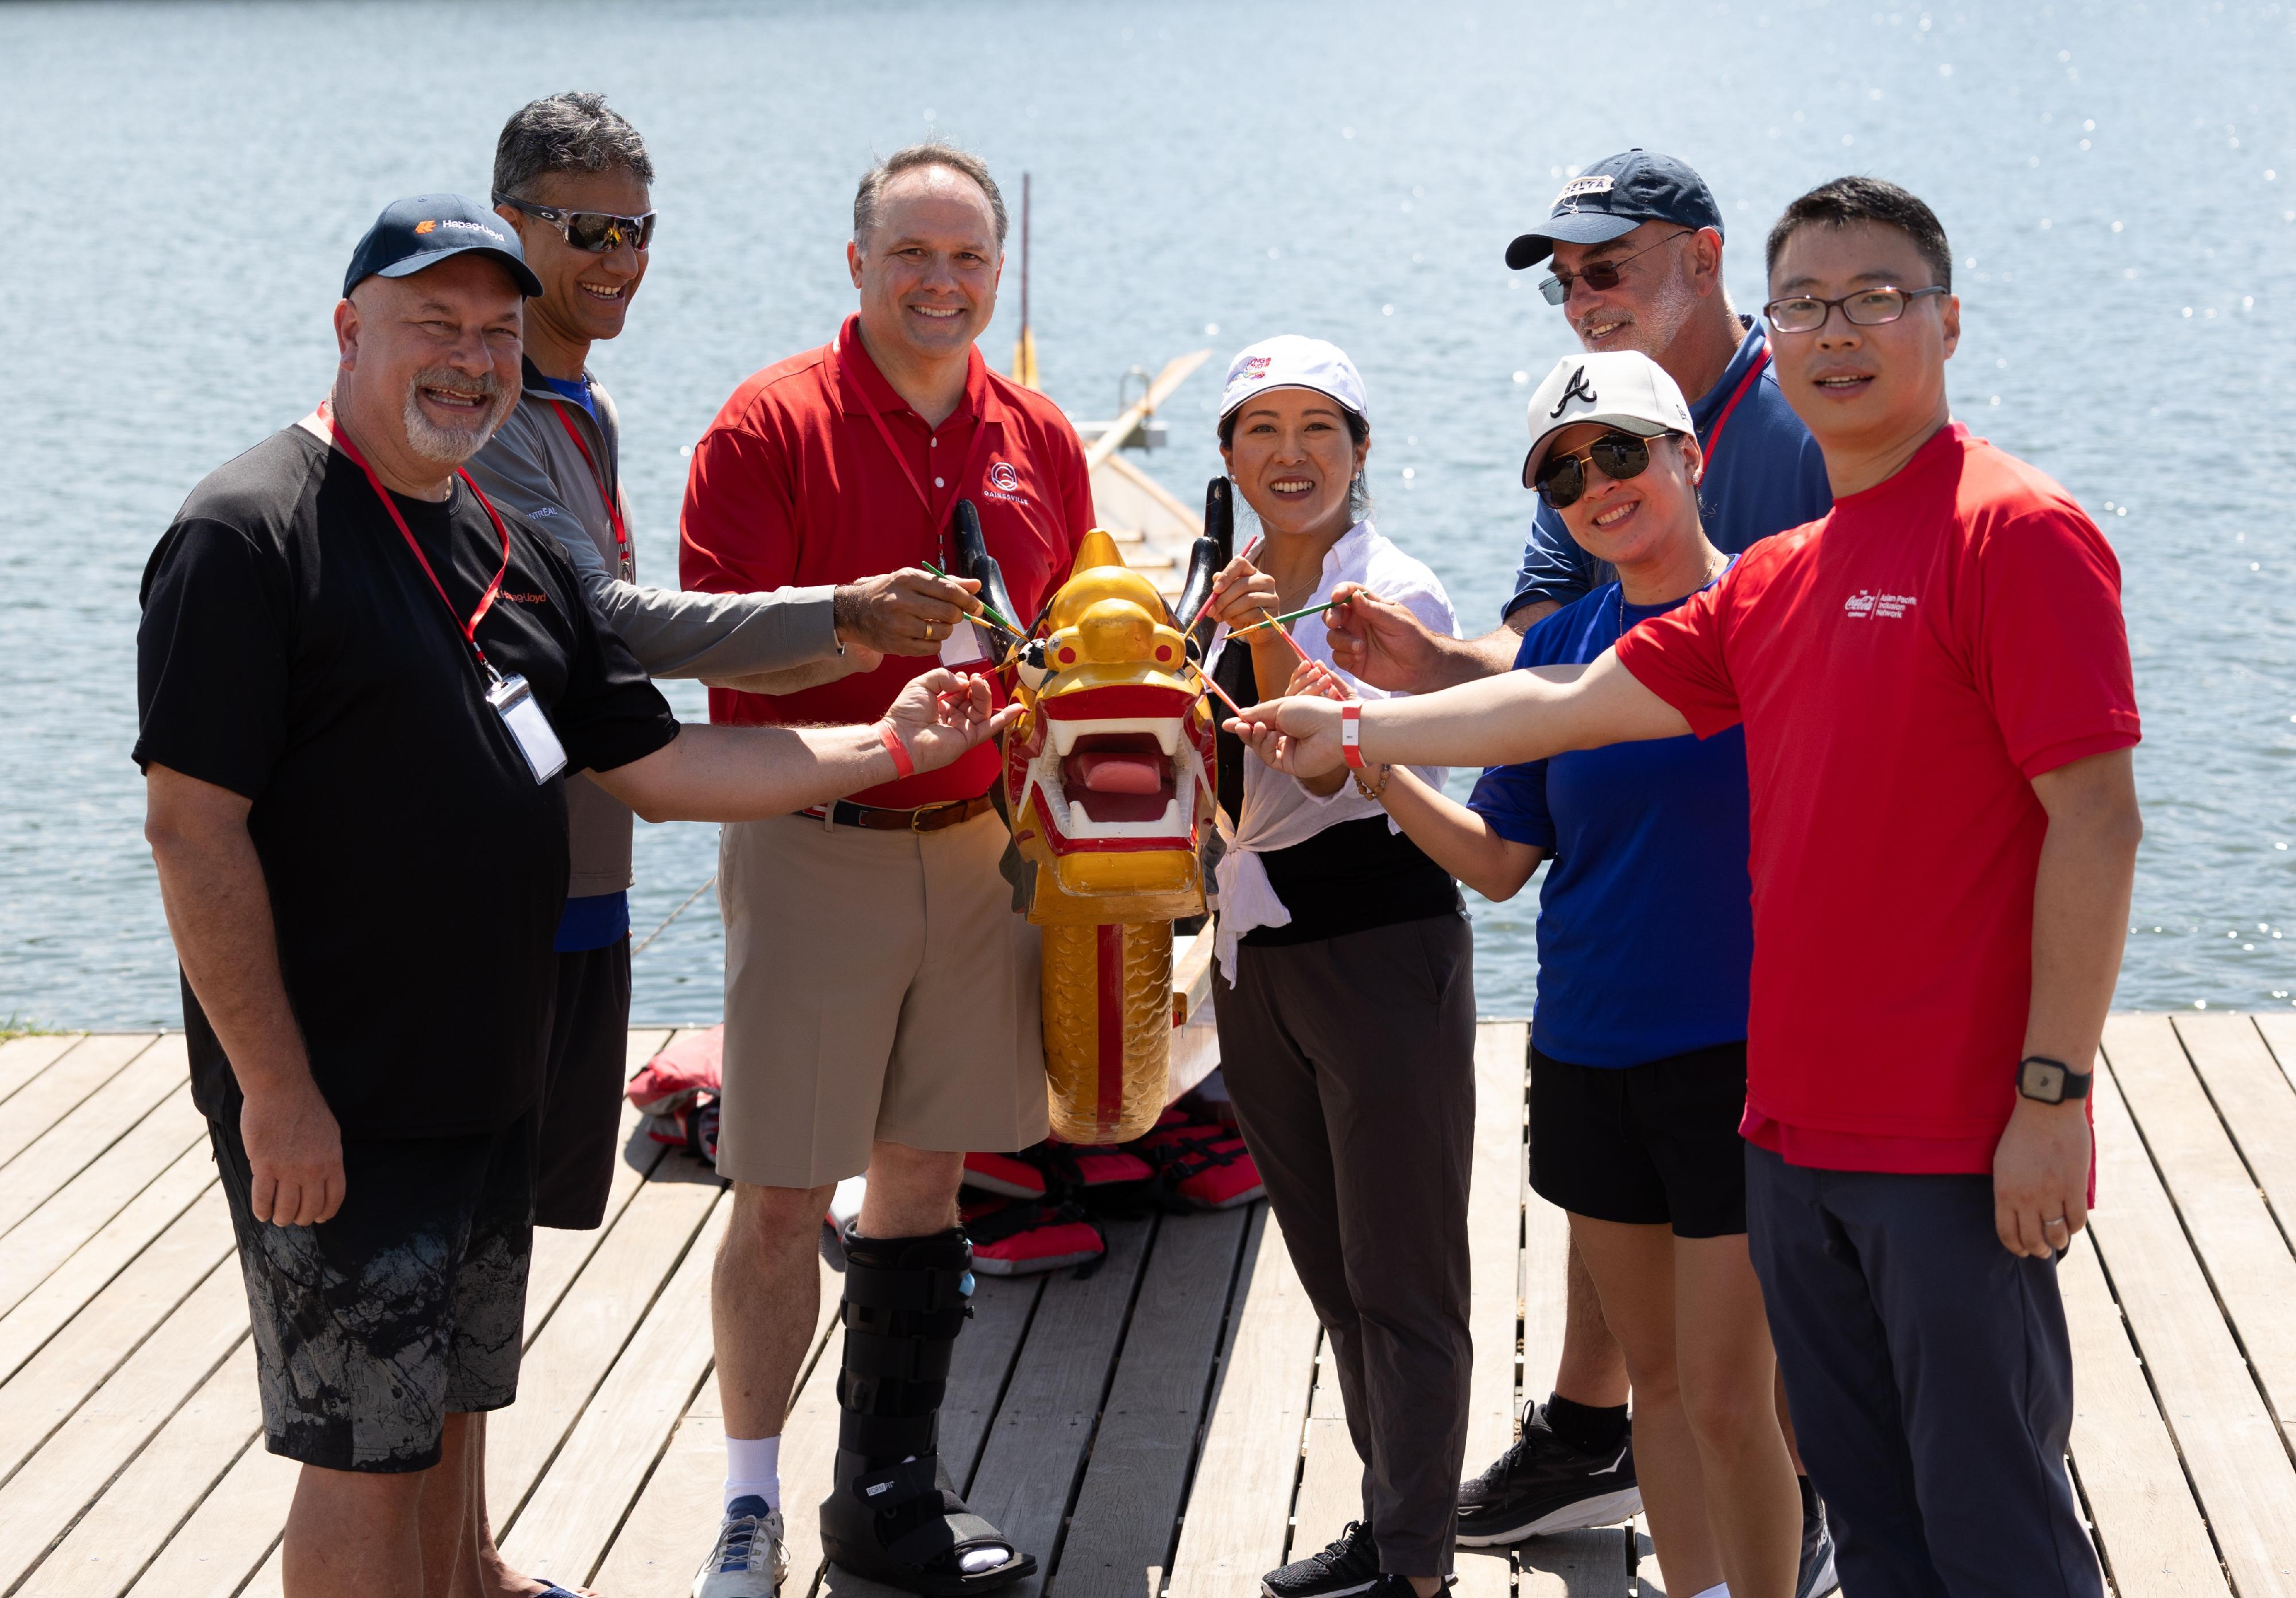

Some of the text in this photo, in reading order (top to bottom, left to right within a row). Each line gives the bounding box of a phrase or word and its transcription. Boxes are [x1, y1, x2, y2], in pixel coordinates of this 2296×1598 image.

[443, 220, 505, 242] Hapag-Lloyd
[1550, 364, 1597, 418] A
[984, 490, 1029, 505] GAINESVILLE
[525, 507, 558, 520] NTRÉAL
[1879, 594, 1896, 602] Asian
